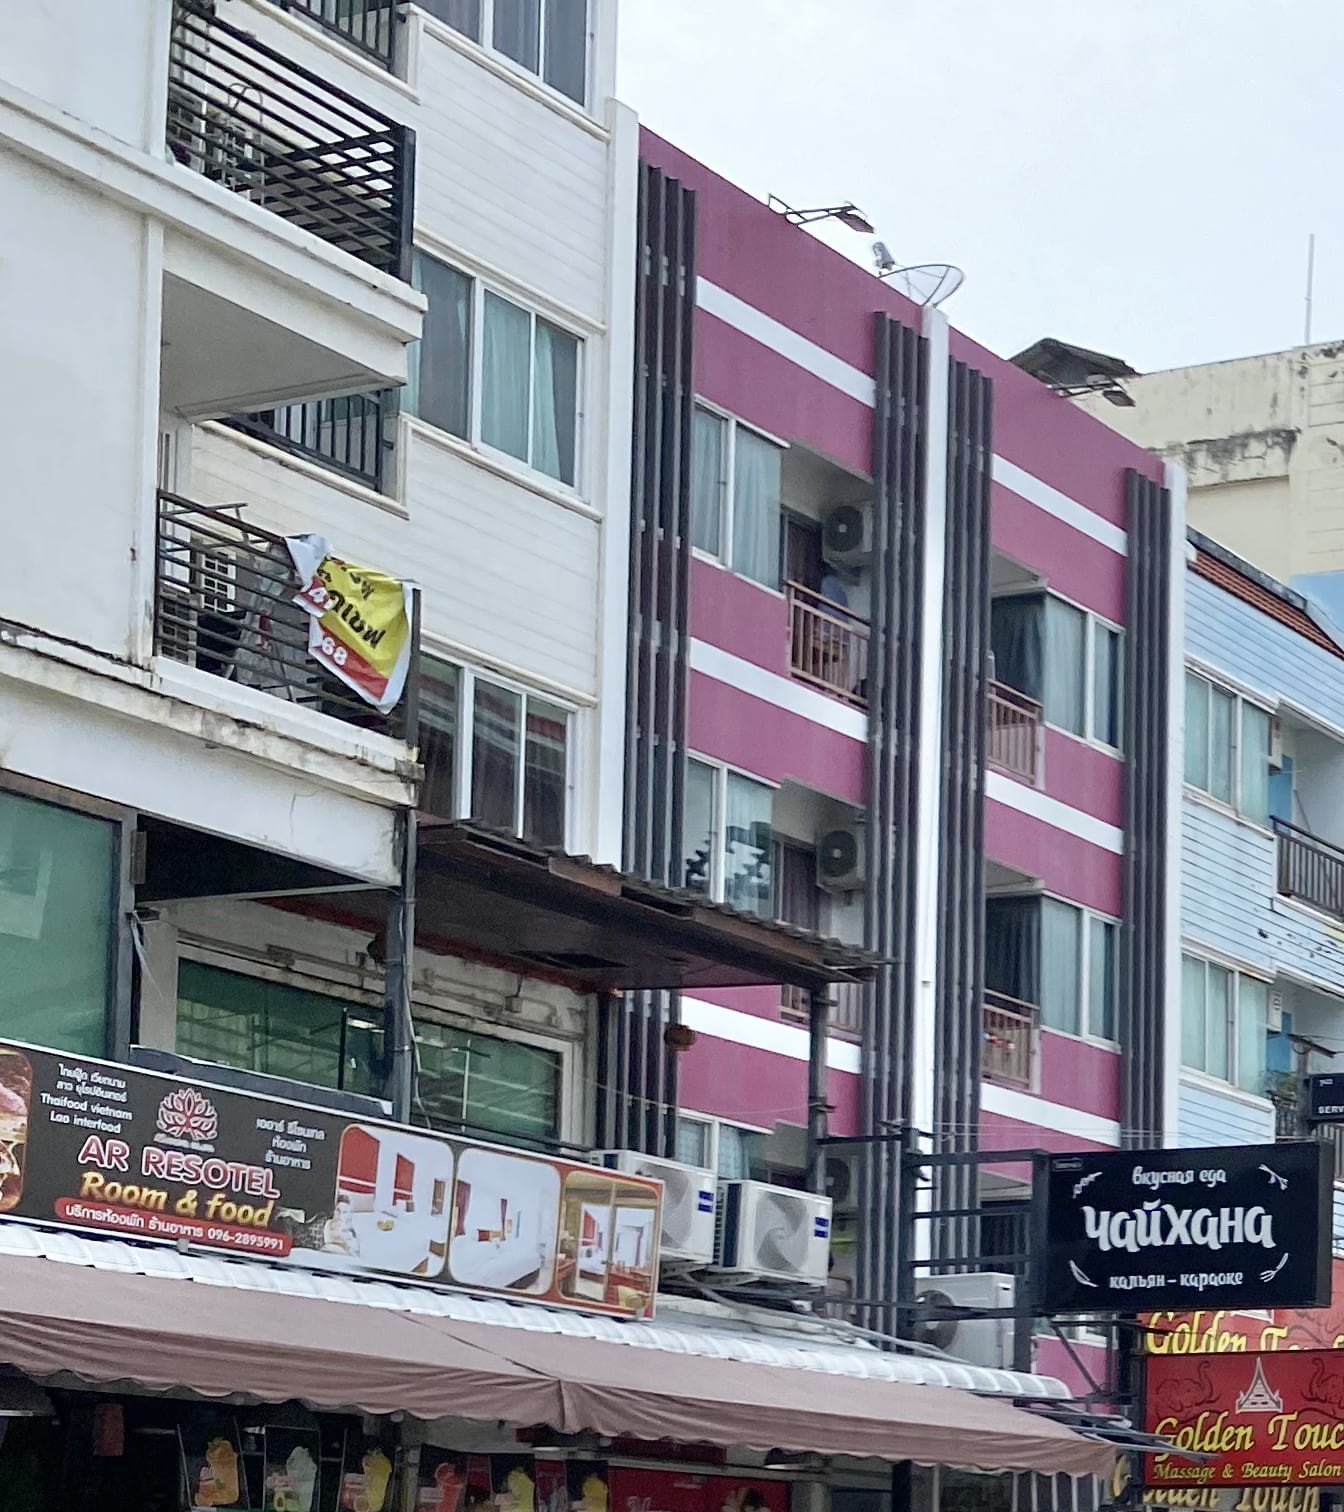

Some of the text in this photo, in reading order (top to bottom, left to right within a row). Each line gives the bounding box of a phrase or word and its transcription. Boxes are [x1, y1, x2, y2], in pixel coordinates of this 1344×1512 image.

[40, 1092, 134, 1121] Thaifood vietnam
[50, 1110, 122, 1134] Lao interfood
[78, 1135, 130, 1172] AR
[142, 1146, 281, 1199] RESOTEL
[1132, 1166, 1227, 1190] вкусная еда
[80, 1171, 275, 1229] Room & food
[65, 1203, 284, 1251] บริการห้องพัก ร้านอาหาร 096-2895991
[1108, 1271, 1244, 1292] кальян караоке
[1154, 1410, 1254, 1462] Golden
[1152, 1462, 1216, 1484] Massage
[1221, 1463, 1234, 1478] &
[1241, 1462, 1293, 1483] Beauty
[1298, 1458, 1342, 1478] Salon
